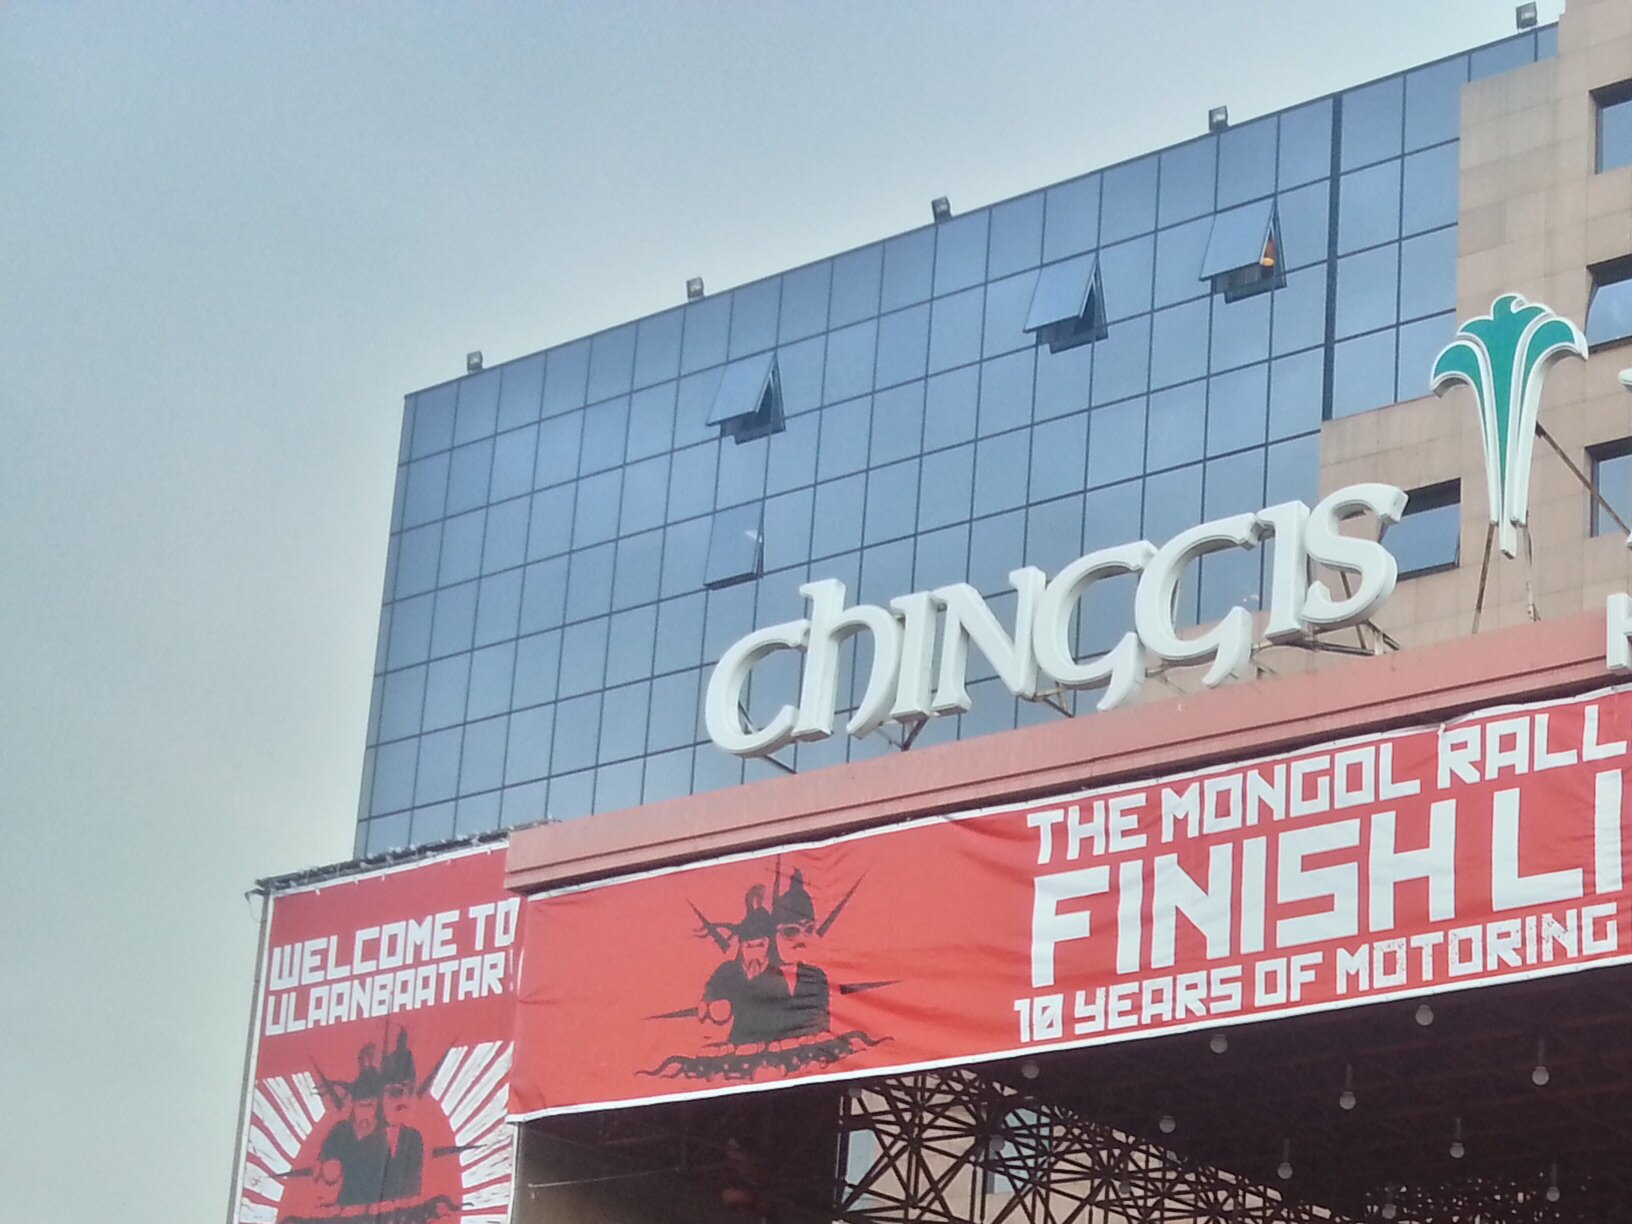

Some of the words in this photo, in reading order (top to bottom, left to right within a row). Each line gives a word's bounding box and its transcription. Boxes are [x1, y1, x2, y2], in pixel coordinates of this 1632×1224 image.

[1027, 793, 1147, 864] THE
[1161, 742, 1421, 843] MONGOL
[269, 909, 460, 991] WELCOME
[468, 896, 520, 950] TO
[1031, 798, 1457, 988] FINISH
[1014, 993, 1064, 1042] 10
[1074, 964, 1243, 1035] YEARS
[1254, 951, 1323, 1008] OF
[1335, 902, 1618, 994] MOTORING
